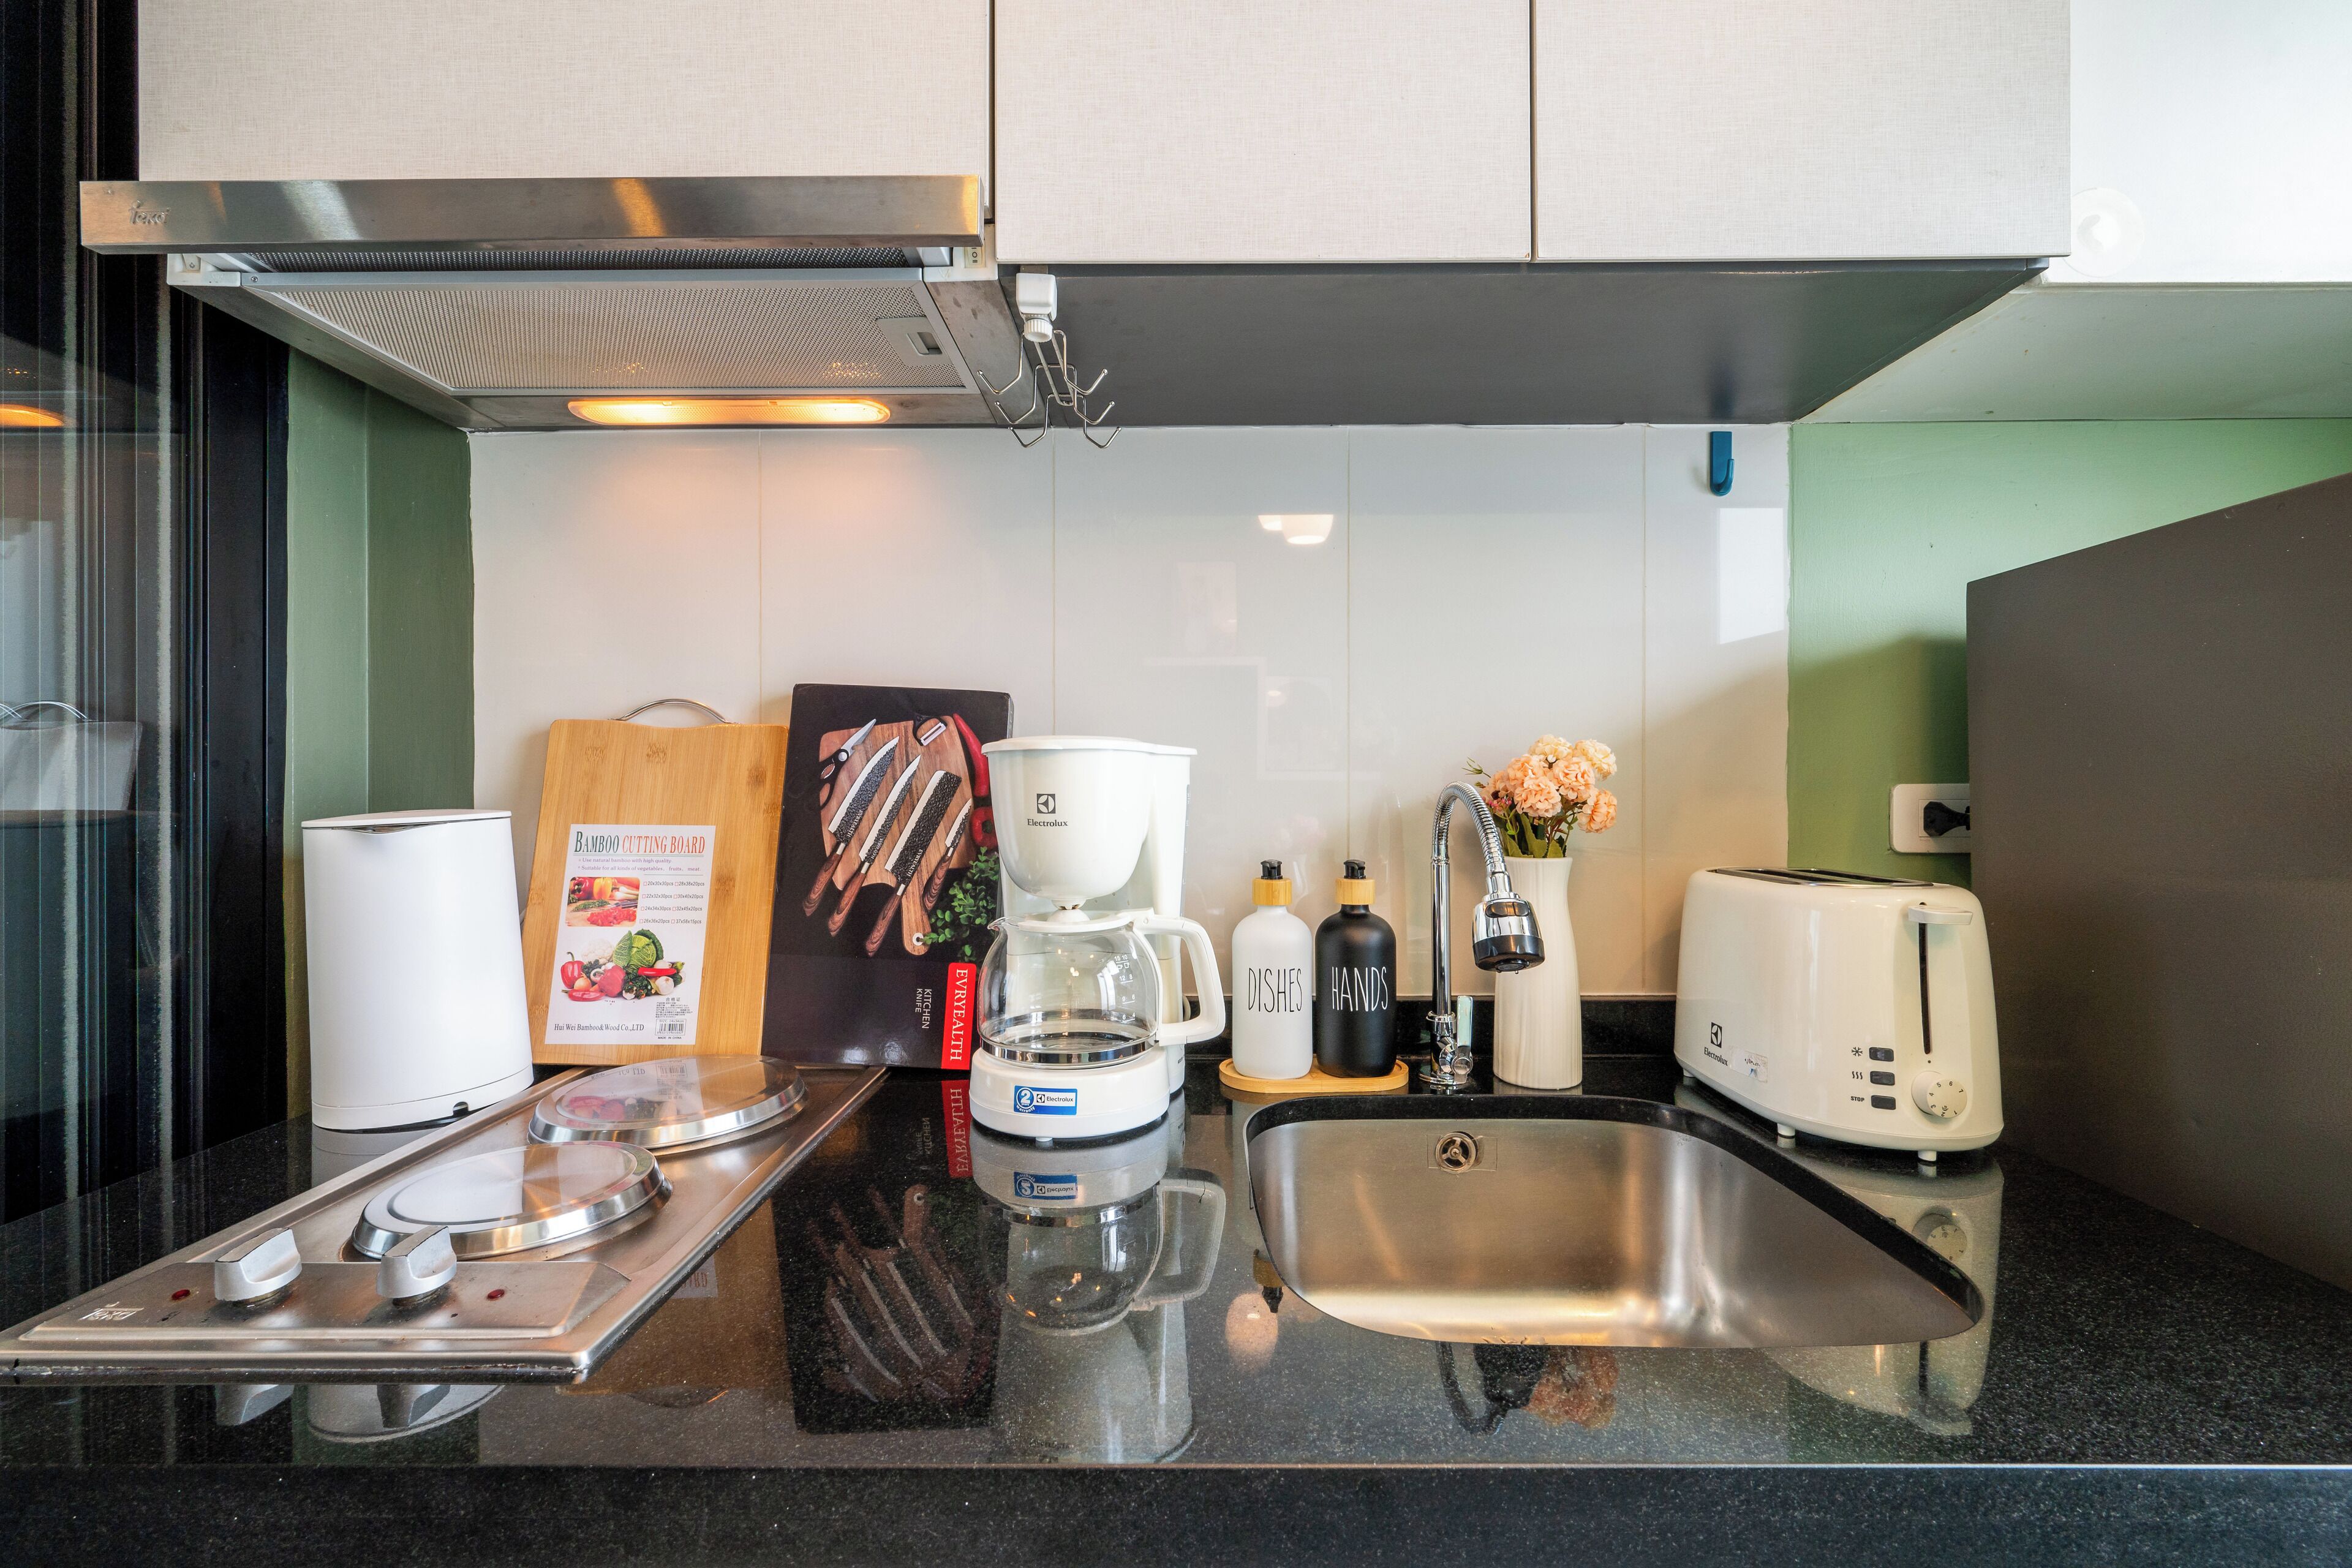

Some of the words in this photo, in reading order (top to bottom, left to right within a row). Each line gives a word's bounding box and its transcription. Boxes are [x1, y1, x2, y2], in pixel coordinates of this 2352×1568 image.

[1027, 818, 1068, 827] Electrolux
[575, 831, 619, 853] BAMBOO
[622, 835, 667, 854] CUTTING
[670, 835, 706, 854] BOARD
[907, 849, 924, 876] EVRYEALTH
[1248, 967, 1302, 1012] DISHES
[1332, 966, 1388, 1012] HANDS
[922, 989, 932, 1029] KITCHEN
[950, 968, 968, 1061] EVRYEALTH
[1704, 1046, 1728, 1066] Electrolux
[1016, 1104, 1036, 1113] warranty
[1020, 1090, 1031, 1104] 2
